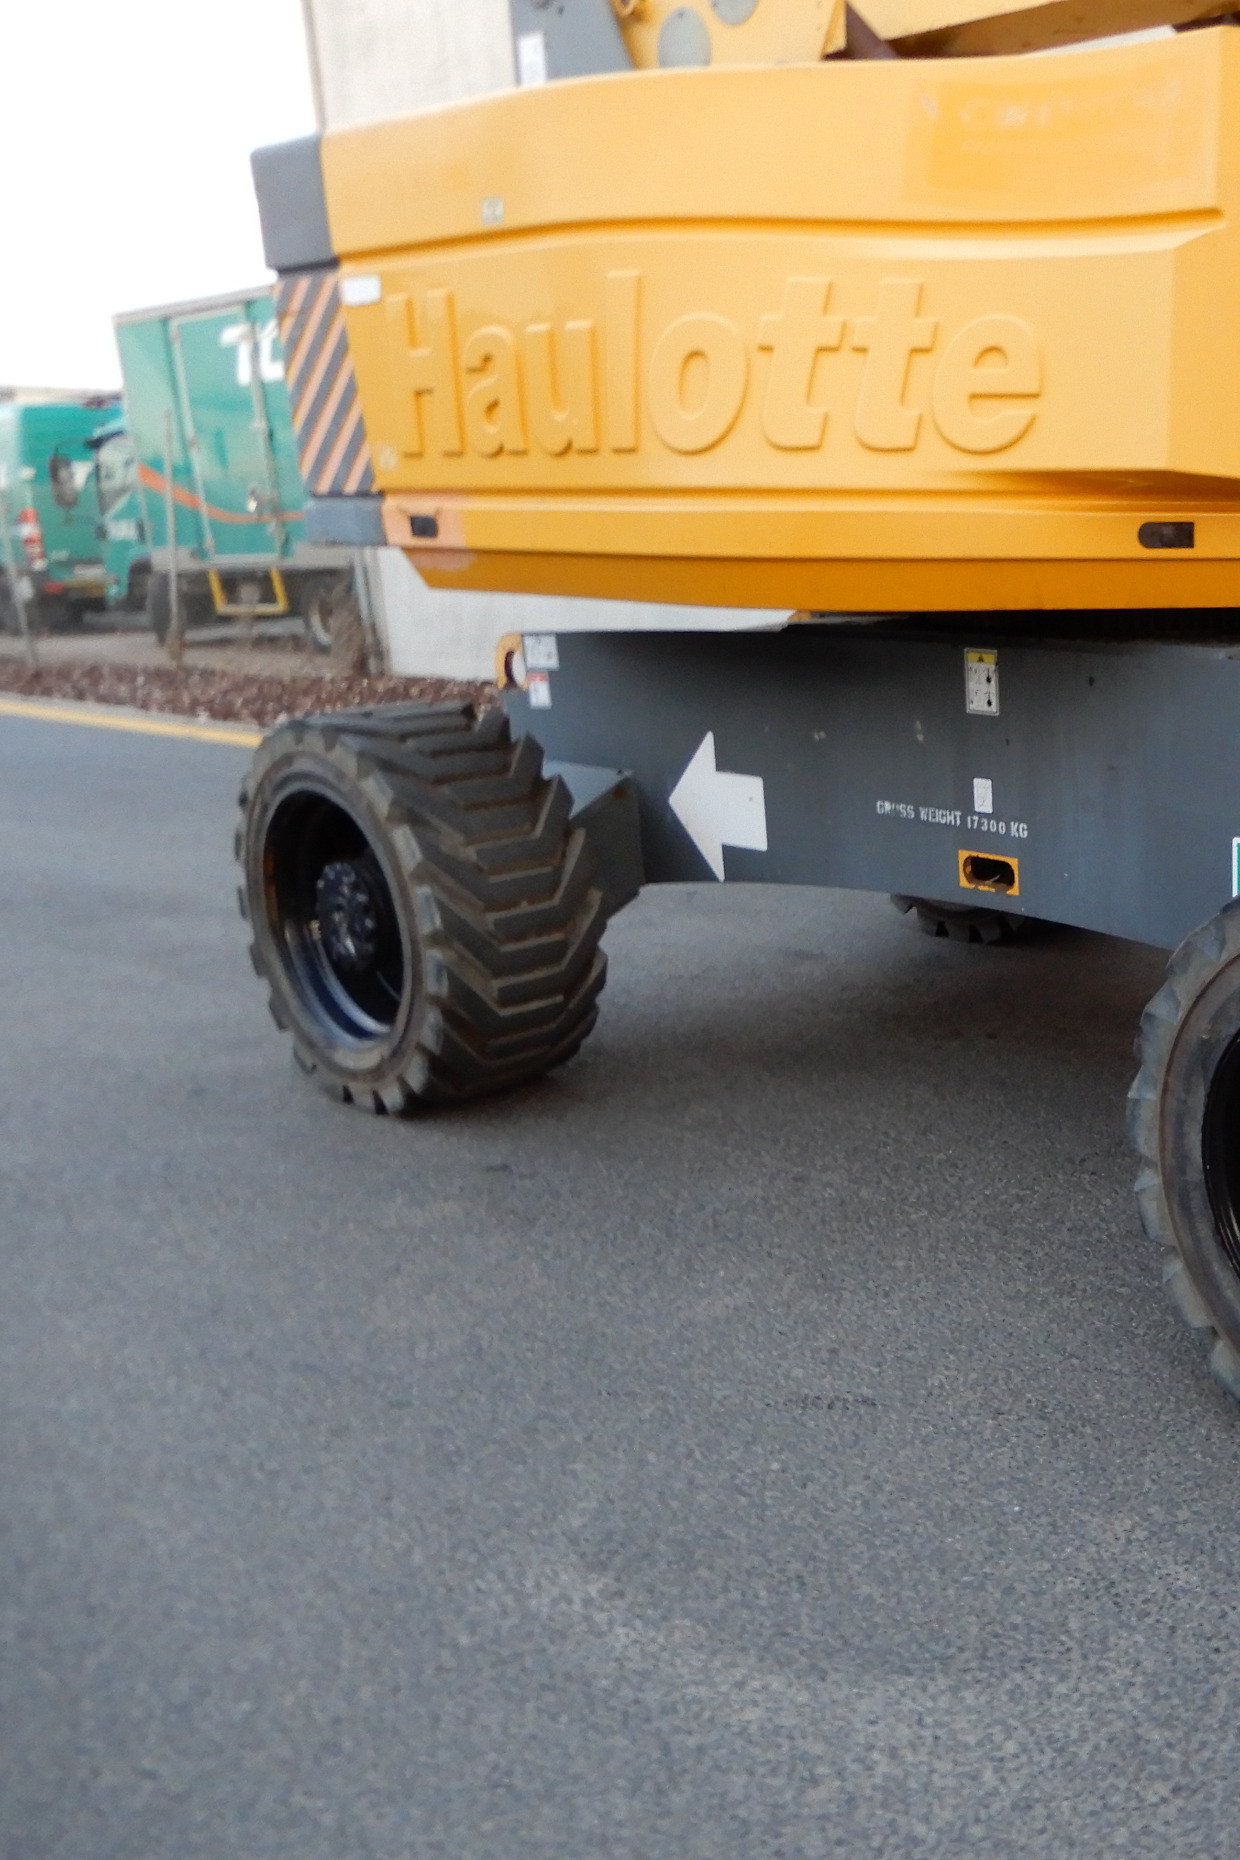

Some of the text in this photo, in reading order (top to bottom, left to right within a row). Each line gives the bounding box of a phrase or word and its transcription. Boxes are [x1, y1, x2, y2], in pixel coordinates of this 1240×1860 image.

[385, 269, 1043, 458] Haulotte
[919, 806, 963, 828] WEIGHT
[967, 815, 1007, 835] 17300
[1010, 821, 1029, 839] KG
